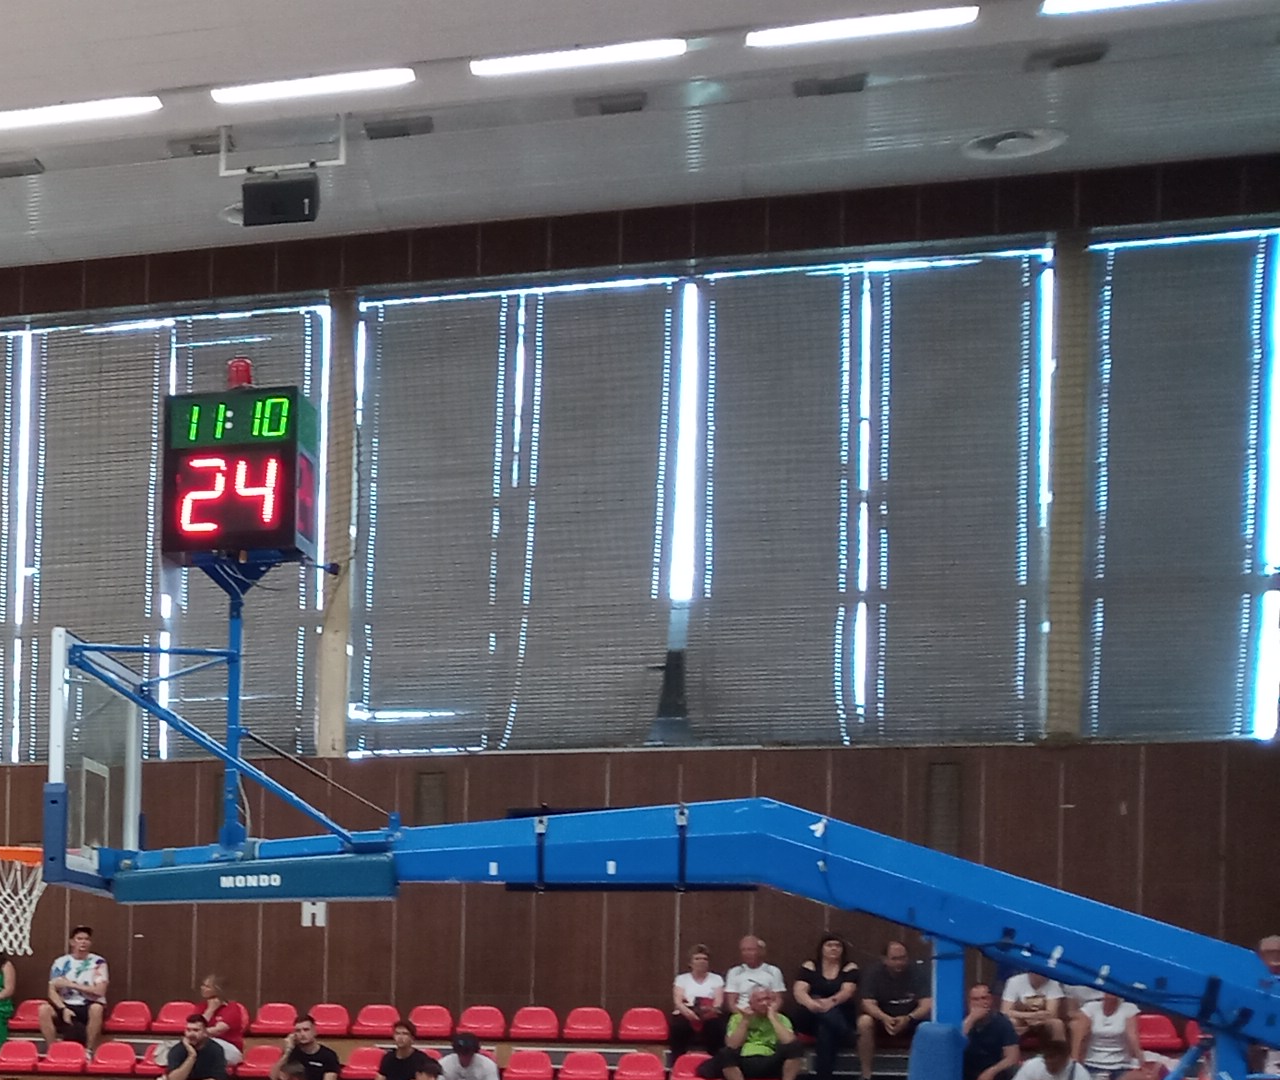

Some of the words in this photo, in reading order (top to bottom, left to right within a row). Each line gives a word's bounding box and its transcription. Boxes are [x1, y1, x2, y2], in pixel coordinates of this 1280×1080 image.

[189, 398, 289, 440] 11:10
[180, 457, 279, 531] 24
[220, 874, 281, 888] MONDO
